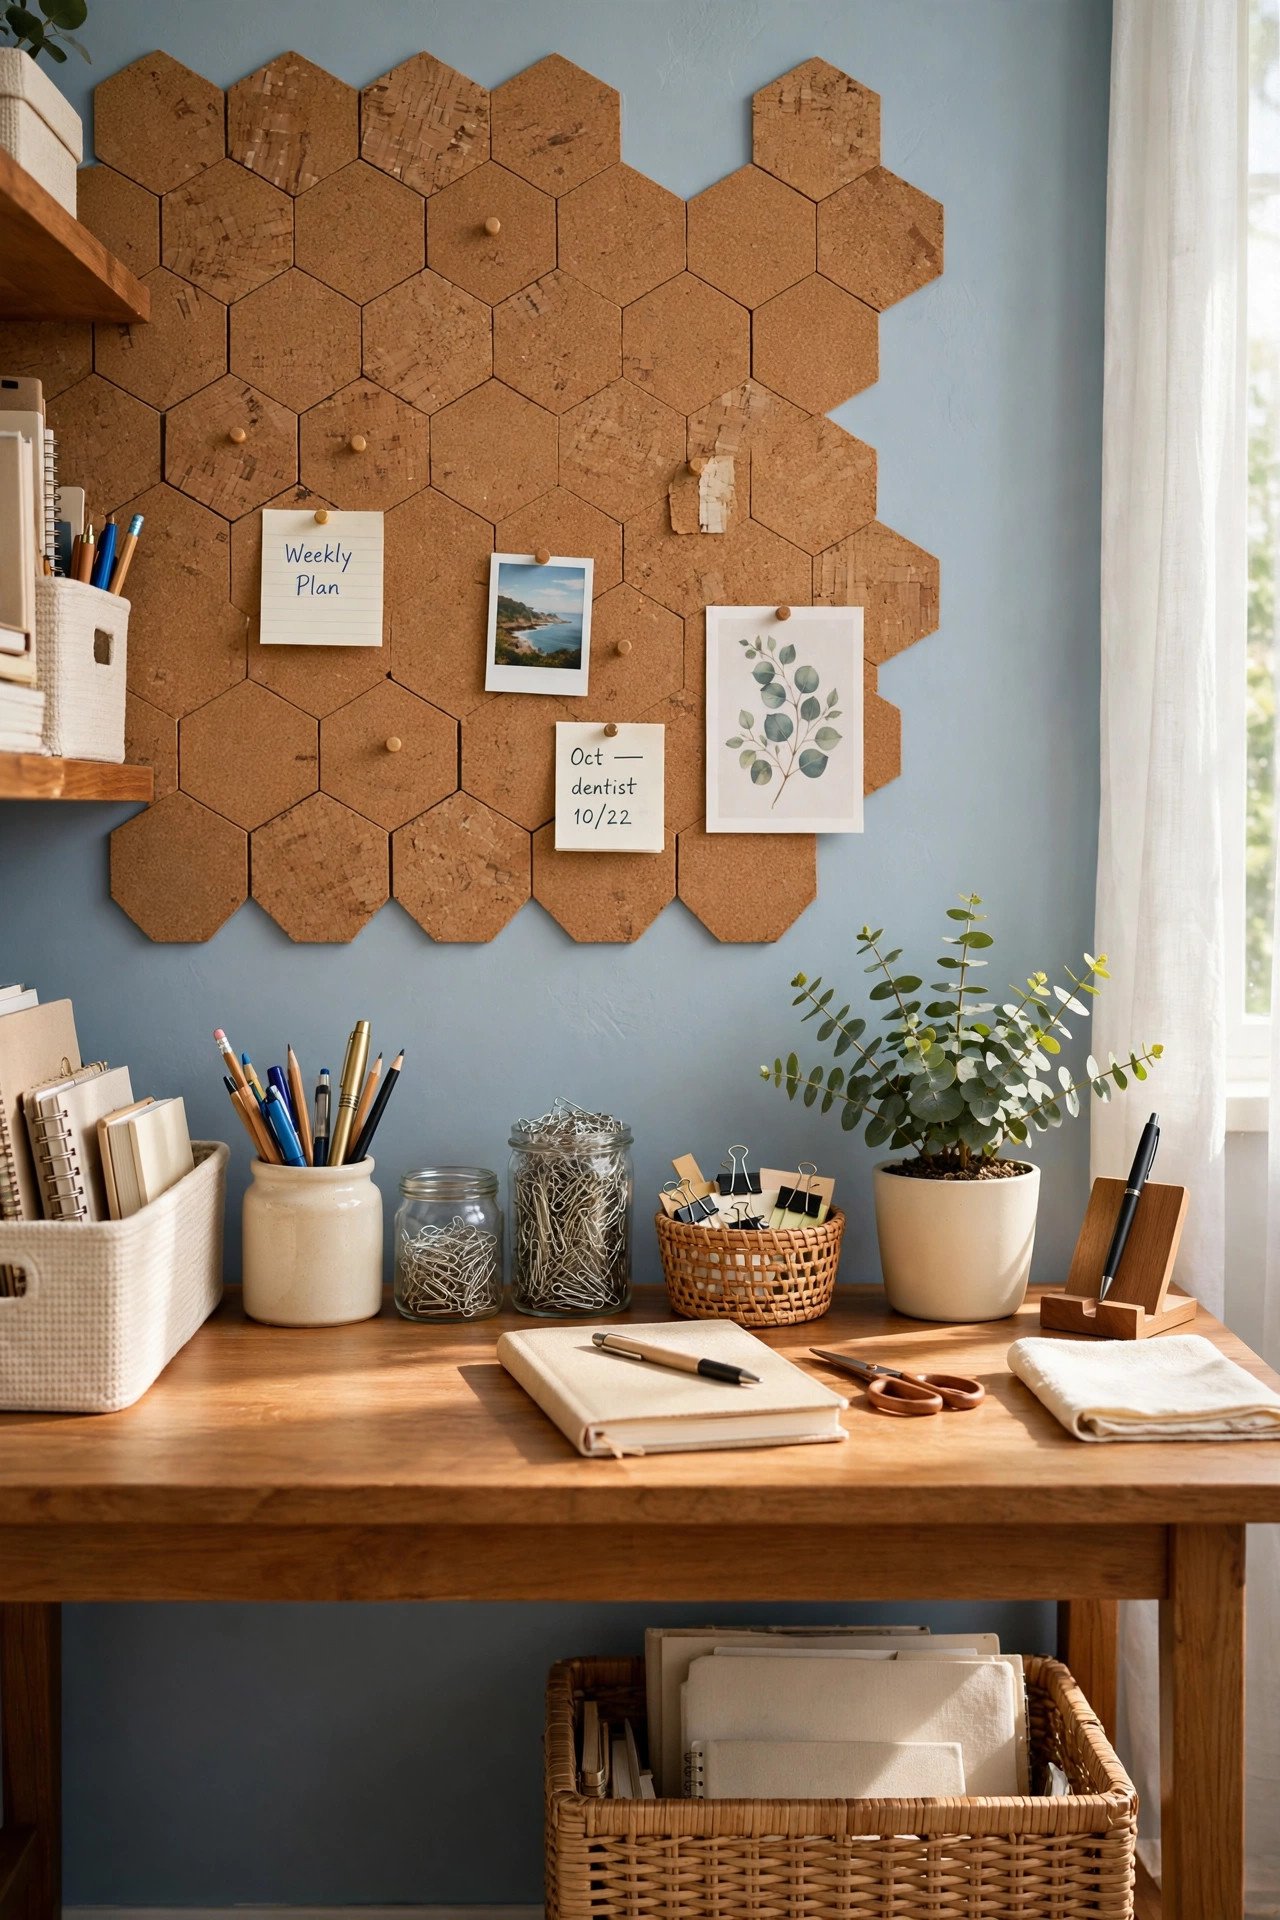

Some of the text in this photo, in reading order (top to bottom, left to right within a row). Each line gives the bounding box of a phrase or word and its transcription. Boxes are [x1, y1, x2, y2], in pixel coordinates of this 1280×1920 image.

[285, 542, 353, 573] Weekly
[295, 574, 340, 596] Plan
[570, 747, 604, 766] Oct
[571, 776, 638, 795] dentist
[573, 803, 632, 830] 10/22
